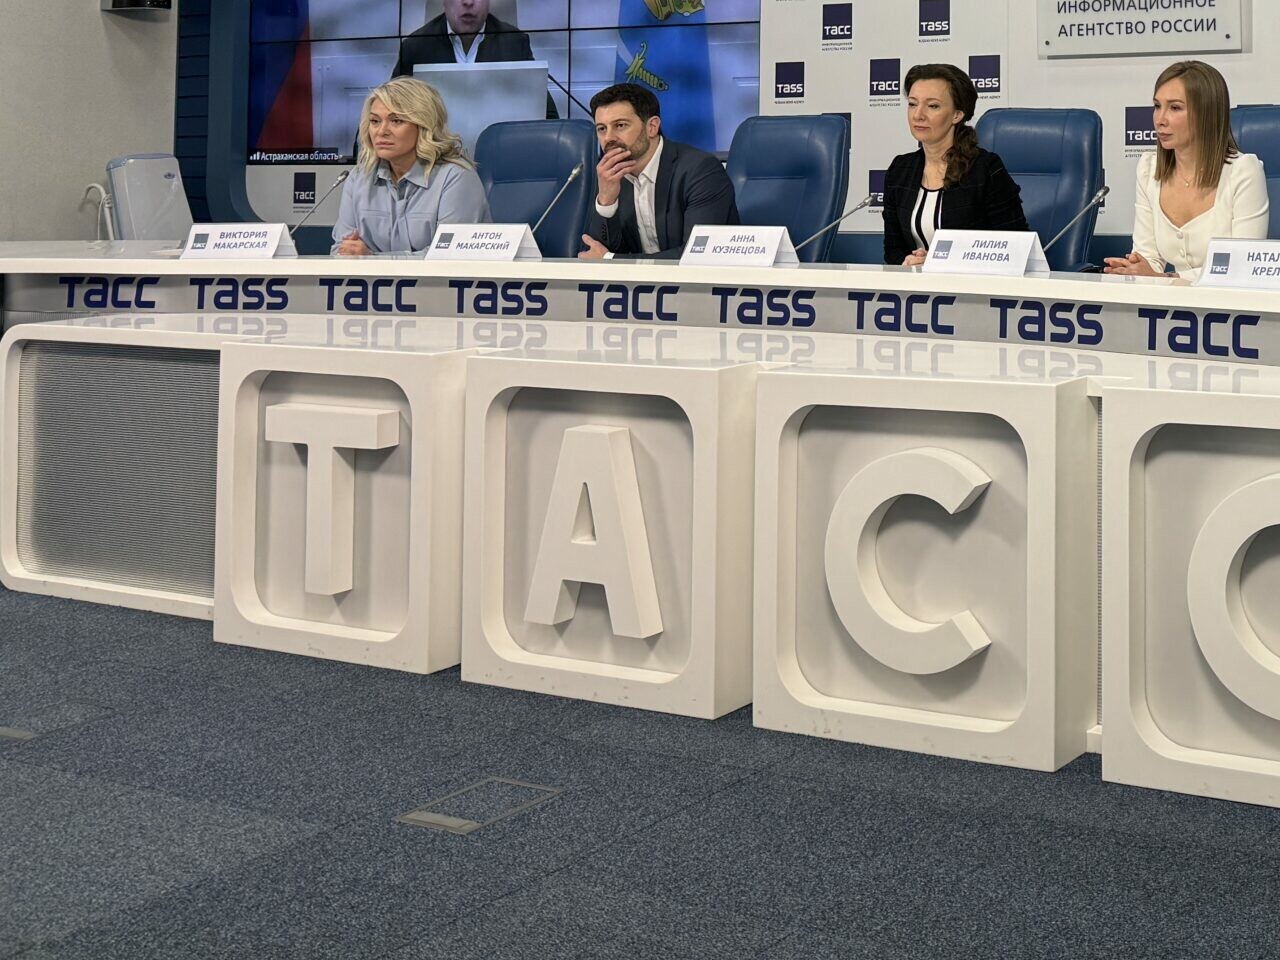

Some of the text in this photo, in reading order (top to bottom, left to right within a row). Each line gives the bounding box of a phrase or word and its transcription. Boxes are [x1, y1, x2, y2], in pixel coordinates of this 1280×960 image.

[1057, 17, 1217, 38] АГЕНТСТВО РОССИИ
[260, 151, 338, 162] Астраханская область
[219, 231, 268, 239] ВИКТОРИЯ
[729, 235, 755, 243] АННА
[213, 241, 268, 249] МАКАРСКАЯ
[455, 241, 510, 250] МАКАРСКИЙ
[971, 239, 1008, 249] ЛИЛИЯ
[712, 246, 766, 255] КУЗНЕЦОВА
[962, 252, 1010, 261] ИВАНОВА
